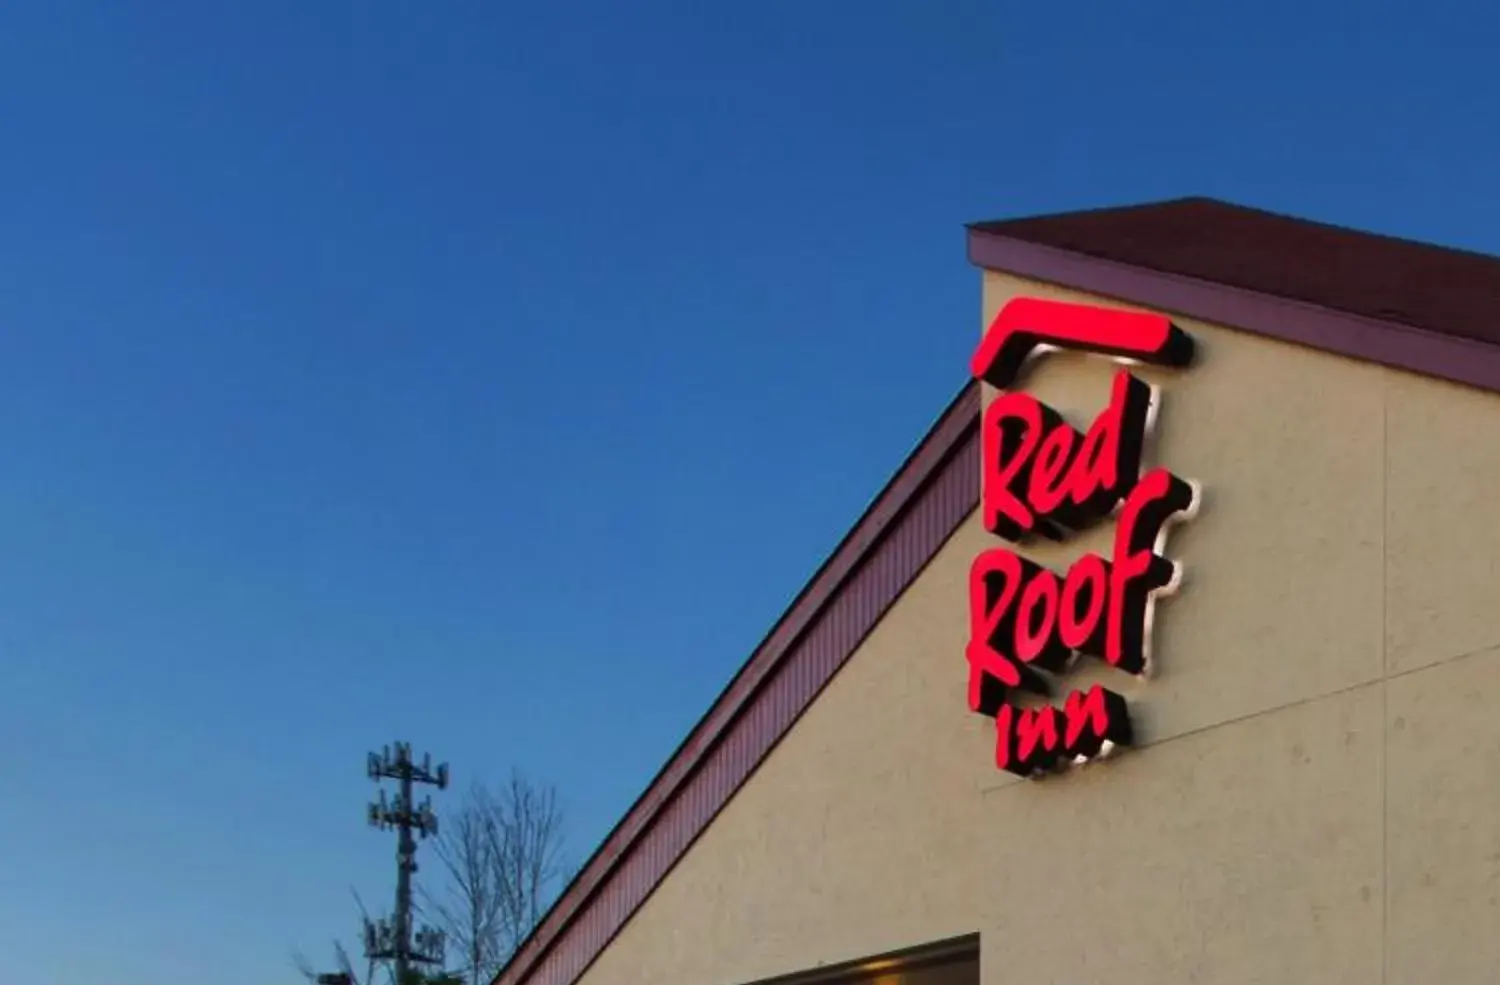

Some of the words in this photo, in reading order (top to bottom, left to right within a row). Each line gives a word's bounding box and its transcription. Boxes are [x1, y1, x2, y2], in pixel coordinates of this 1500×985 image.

[984, 368, 1131, 532] Red
[966, 468, 1171, 712] Roof
[995, 684, 1109, 771] Inn
